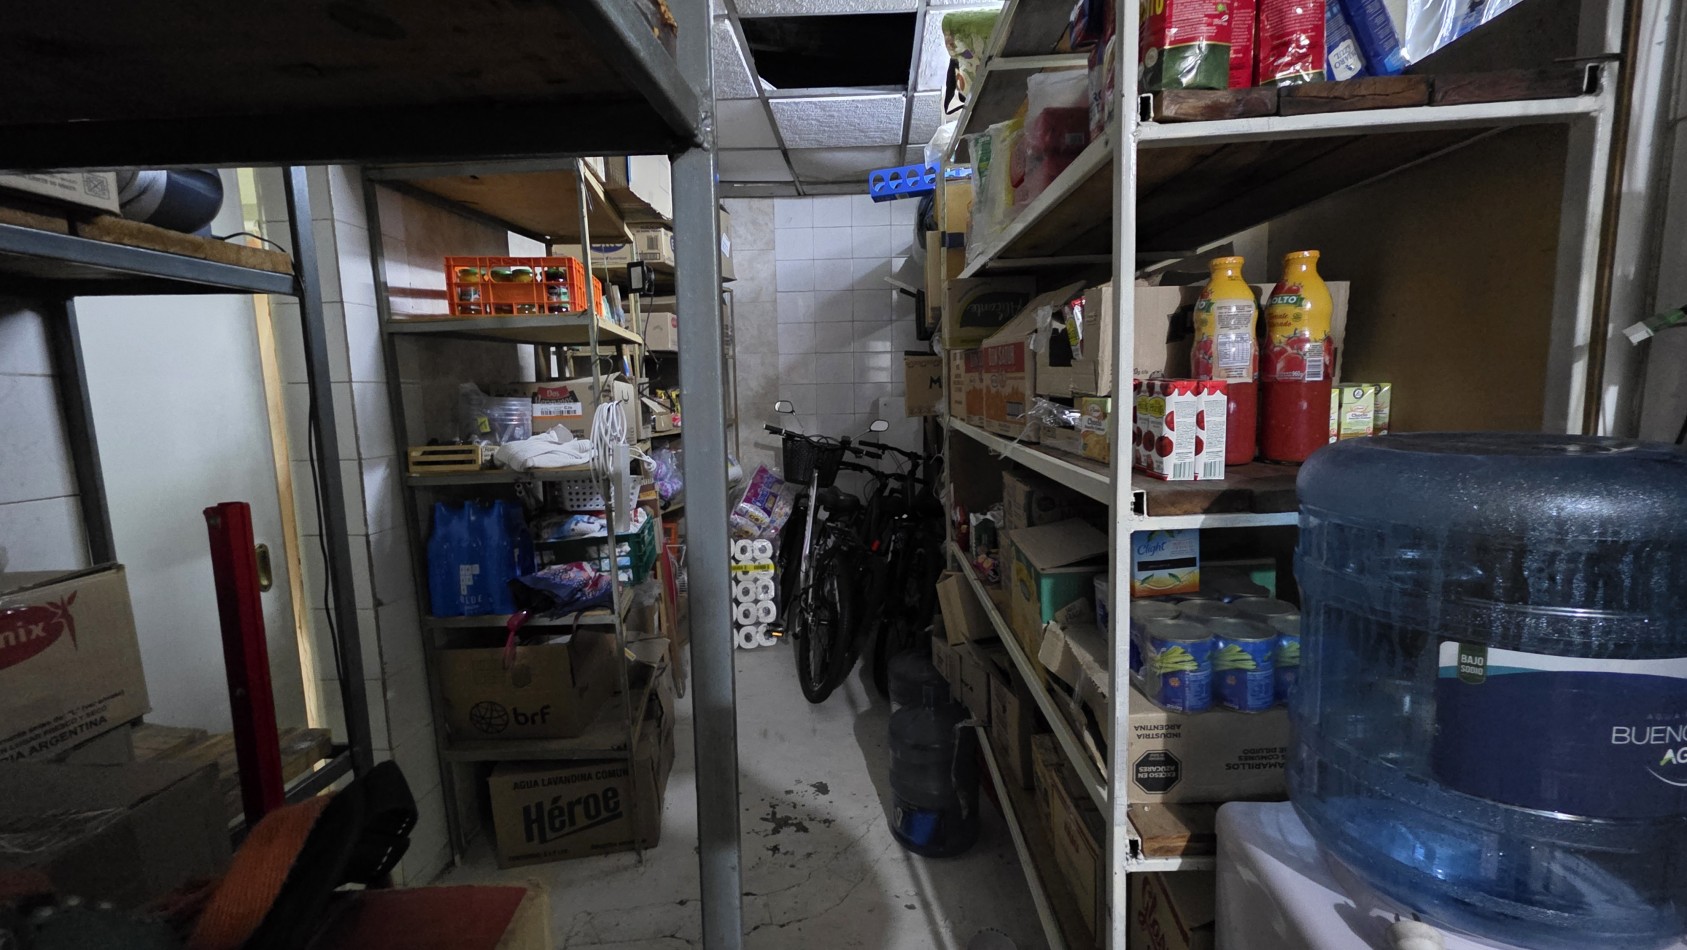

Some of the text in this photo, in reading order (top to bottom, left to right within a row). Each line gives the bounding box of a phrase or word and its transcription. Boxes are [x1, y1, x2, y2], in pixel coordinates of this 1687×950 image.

[1137, 541, 1167, 556] Clight
[1461, 654, 1484, 665] BAJO
[1460, 665, 1484, 676] SODIO
[512, 704, 551, 726] brf
[28, 716, 108, 755] ARGENTINA
[1136, 732, 1182, 740] INDUSTRIA
[1611, 725, 1687, 745] BUEN
[1225, 762, 1285, 770] AMARILLOS
[513, 779, 540, 791] AGUA
[541, 771, 593, 787] LAVANDINA
[522, 786, 621, 845] Héroe
